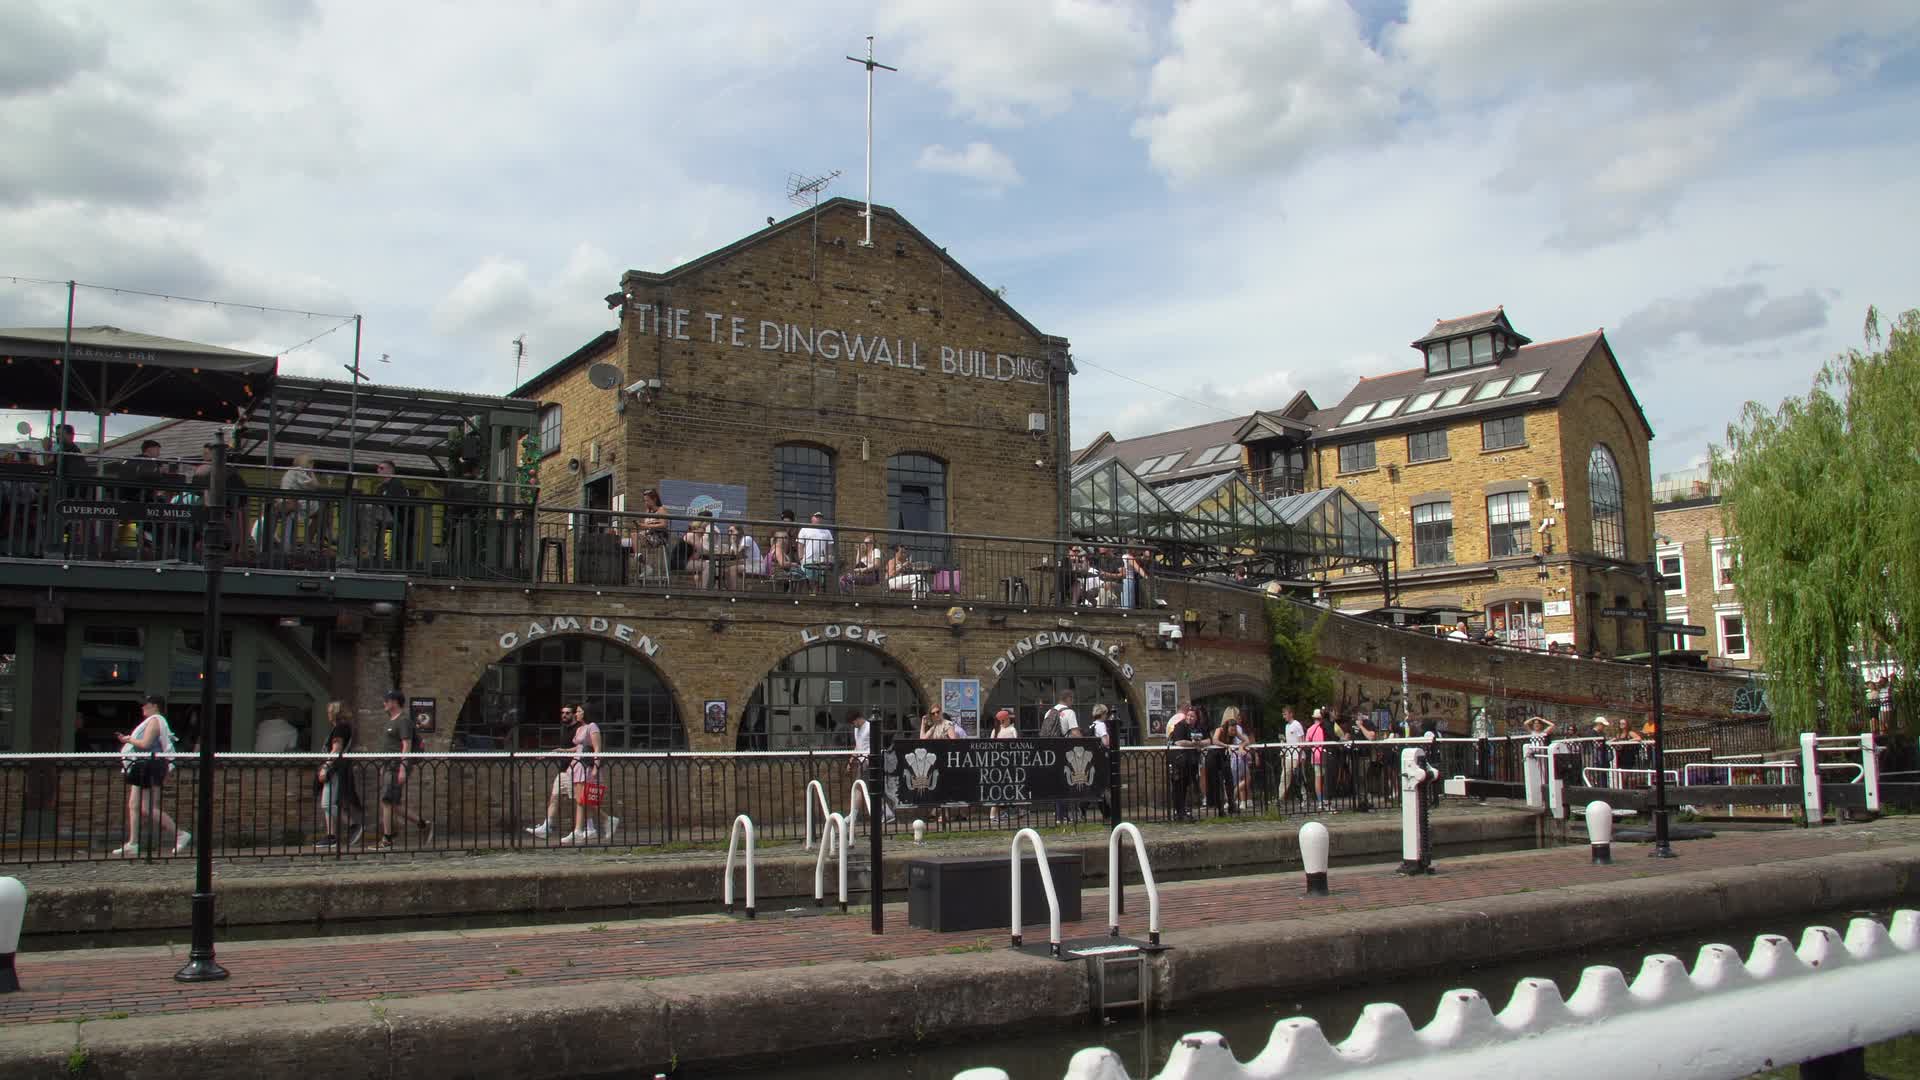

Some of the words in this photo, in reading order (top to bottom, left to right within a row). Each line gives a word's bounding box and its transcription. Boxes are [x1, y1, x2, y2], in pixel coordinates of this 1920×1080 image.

[634, 303, 690, 341] THE
[760, 320, 925, 370] DINGWALL
[941, 346, 1044, 381] BUILDING
[63, 506, 118, 515] LIVERPOOL
[162, 509, 192, 518] MILES
[499, 616, 660, 657] CAMDEN
[801, 624, 887, 646] LOCK
[1009, 742, 1035, 750] CANAL
[946, 750, 1056, 768] HAMPSTEAD
[979, 767, 1026, 785] ROAD
[979, 784, 1027, 801] LOCK
